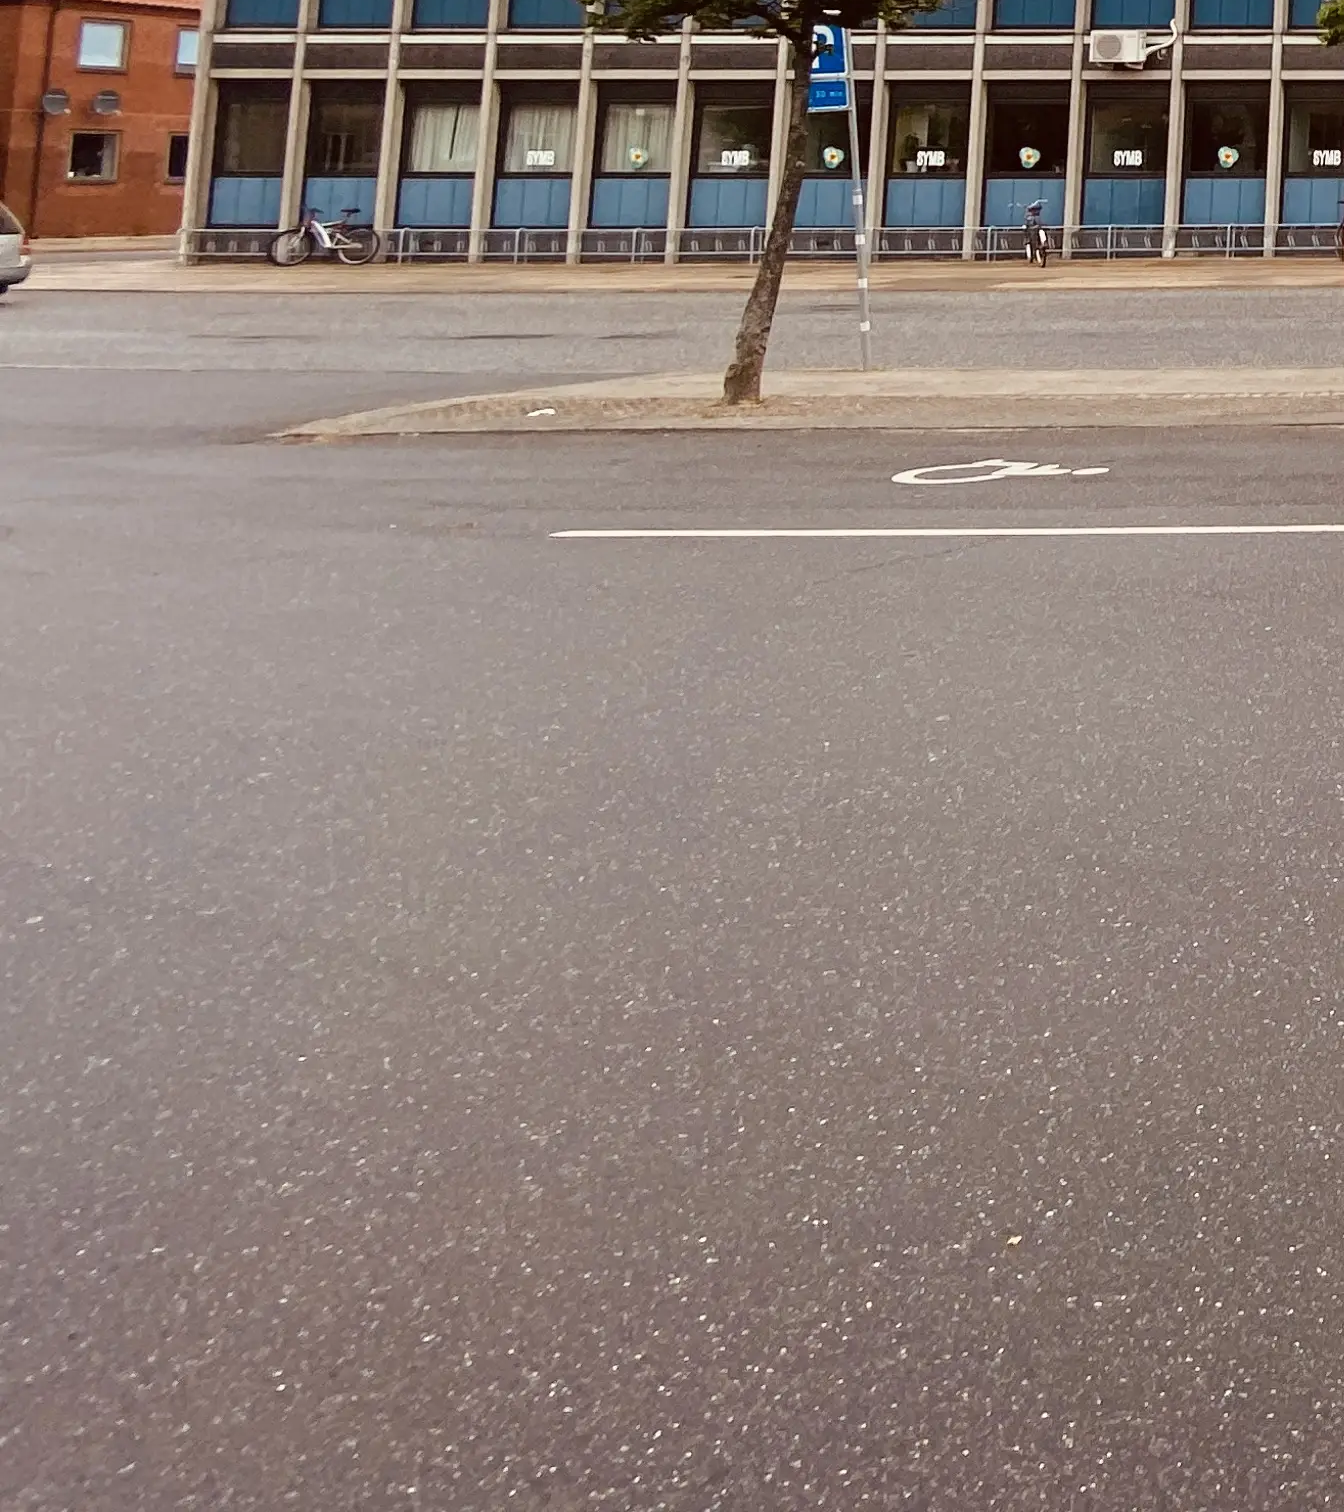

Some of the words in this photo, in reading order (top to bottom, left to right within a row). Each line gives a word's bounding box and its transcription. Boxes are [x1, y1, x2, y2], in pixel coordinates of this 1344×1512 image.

[812, 25, 834, 69] P
[917, 150, 945, 166] SYMB
[1113, 150, 1142, 166] SYMB
[1312, 149, 1341, 166] SYMB
